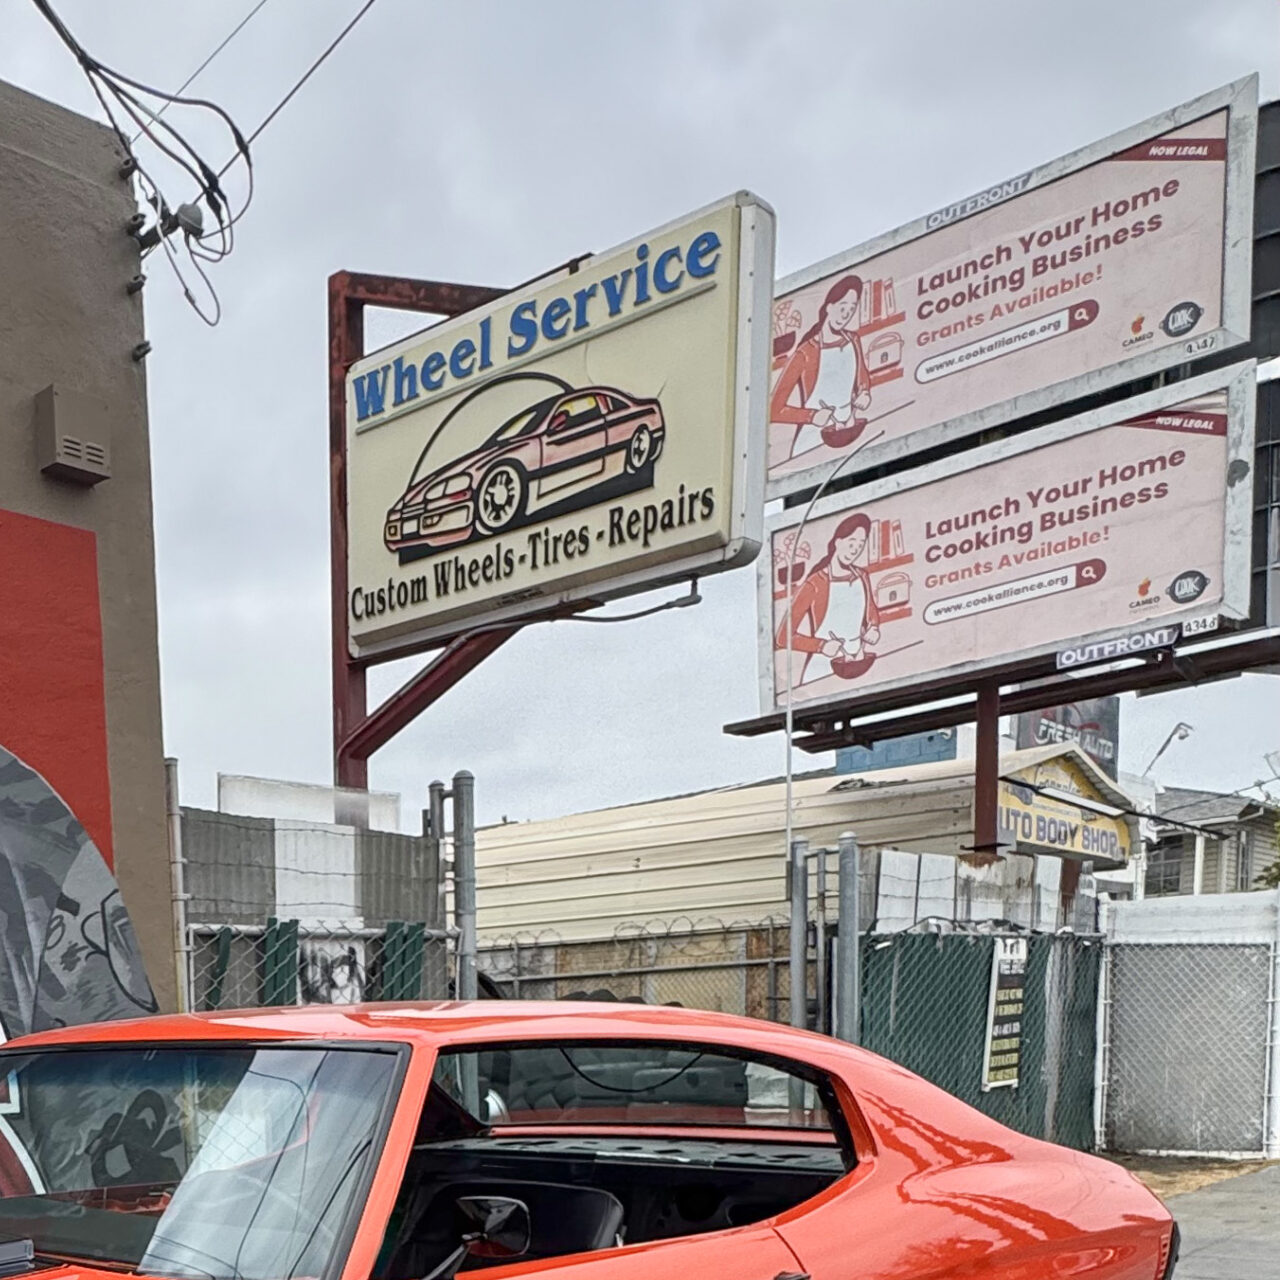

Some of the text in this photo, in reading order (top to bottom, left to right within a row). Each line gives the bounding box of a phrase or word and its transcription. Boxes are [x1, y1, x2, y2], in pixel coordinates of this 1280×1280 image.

[1149, 146, 1209, 156] NOW LEGAL
[928, 175, 1028, 227] OUTFRONT
[918, 179, 1180, 295] Launch Your Home
[917, 214, 1162, 320] Cooking Business
[352, 231, 722, 422] Wheel Service
[917, 264, 1102, 347] Grants Available!
[925, 319, 1061, 374] www.cookalliance.org
[1156, 416, 1214, 430] NOW LEGAL
[925, 450, 1186, 539] Launch Your Home
[925, 482, 1169, 563] Cooking Business
[925, 525, 1109, 588] Grants Available!
[351, 578, 428, 622] Custom
[933, 576, 1068, 617] www.cookalliance.org
[1062, 629, 1174, 665] OUTFRONT
[1084, 735, 1114, 759] AUTO
[999, 805, 1032, 839] UTO
[1036, 815, 1078, 848] BODY
[1082, 825, 1118, 857] SHOP
